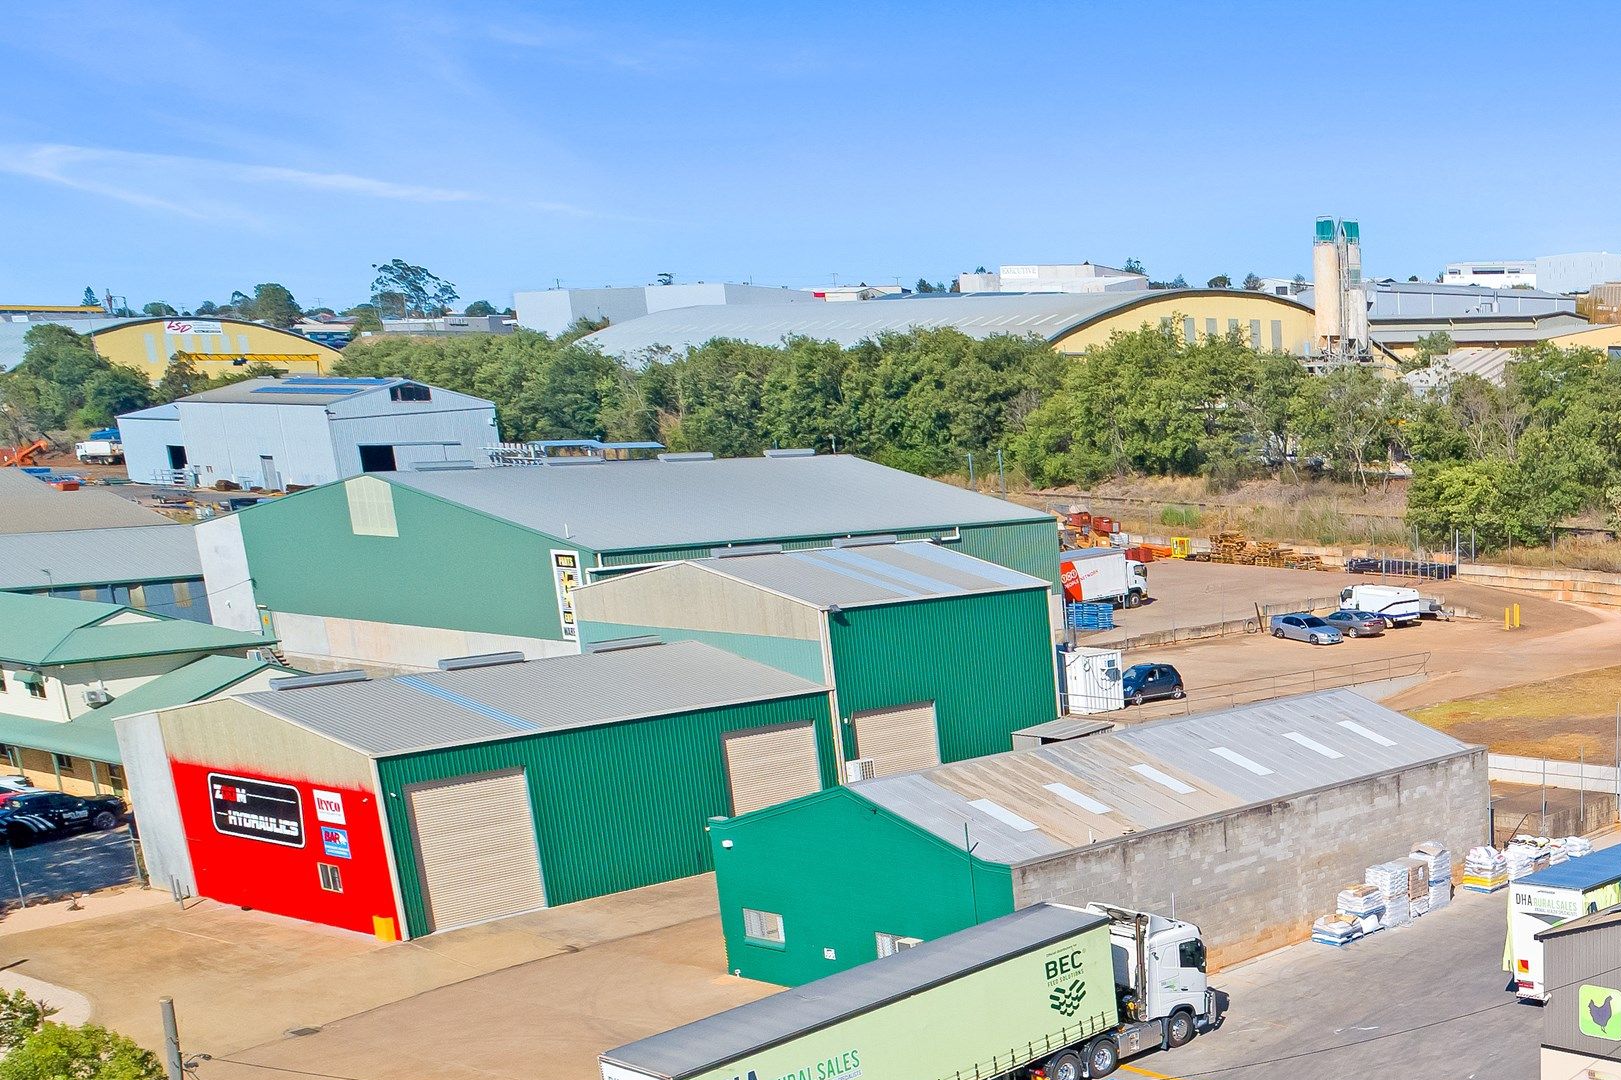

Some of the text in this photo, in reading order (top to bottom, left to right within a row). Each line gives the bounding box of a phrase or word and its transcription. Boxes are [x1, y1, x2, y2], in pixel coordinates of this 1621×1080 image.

[317, 797, 341, 813] RYCO
[227, 809, 299, 837] HYDRAULICS
[1515, 893, 1578, 911] DHA RURAL SALES
[1045, 950, 1083, 980] BEC
